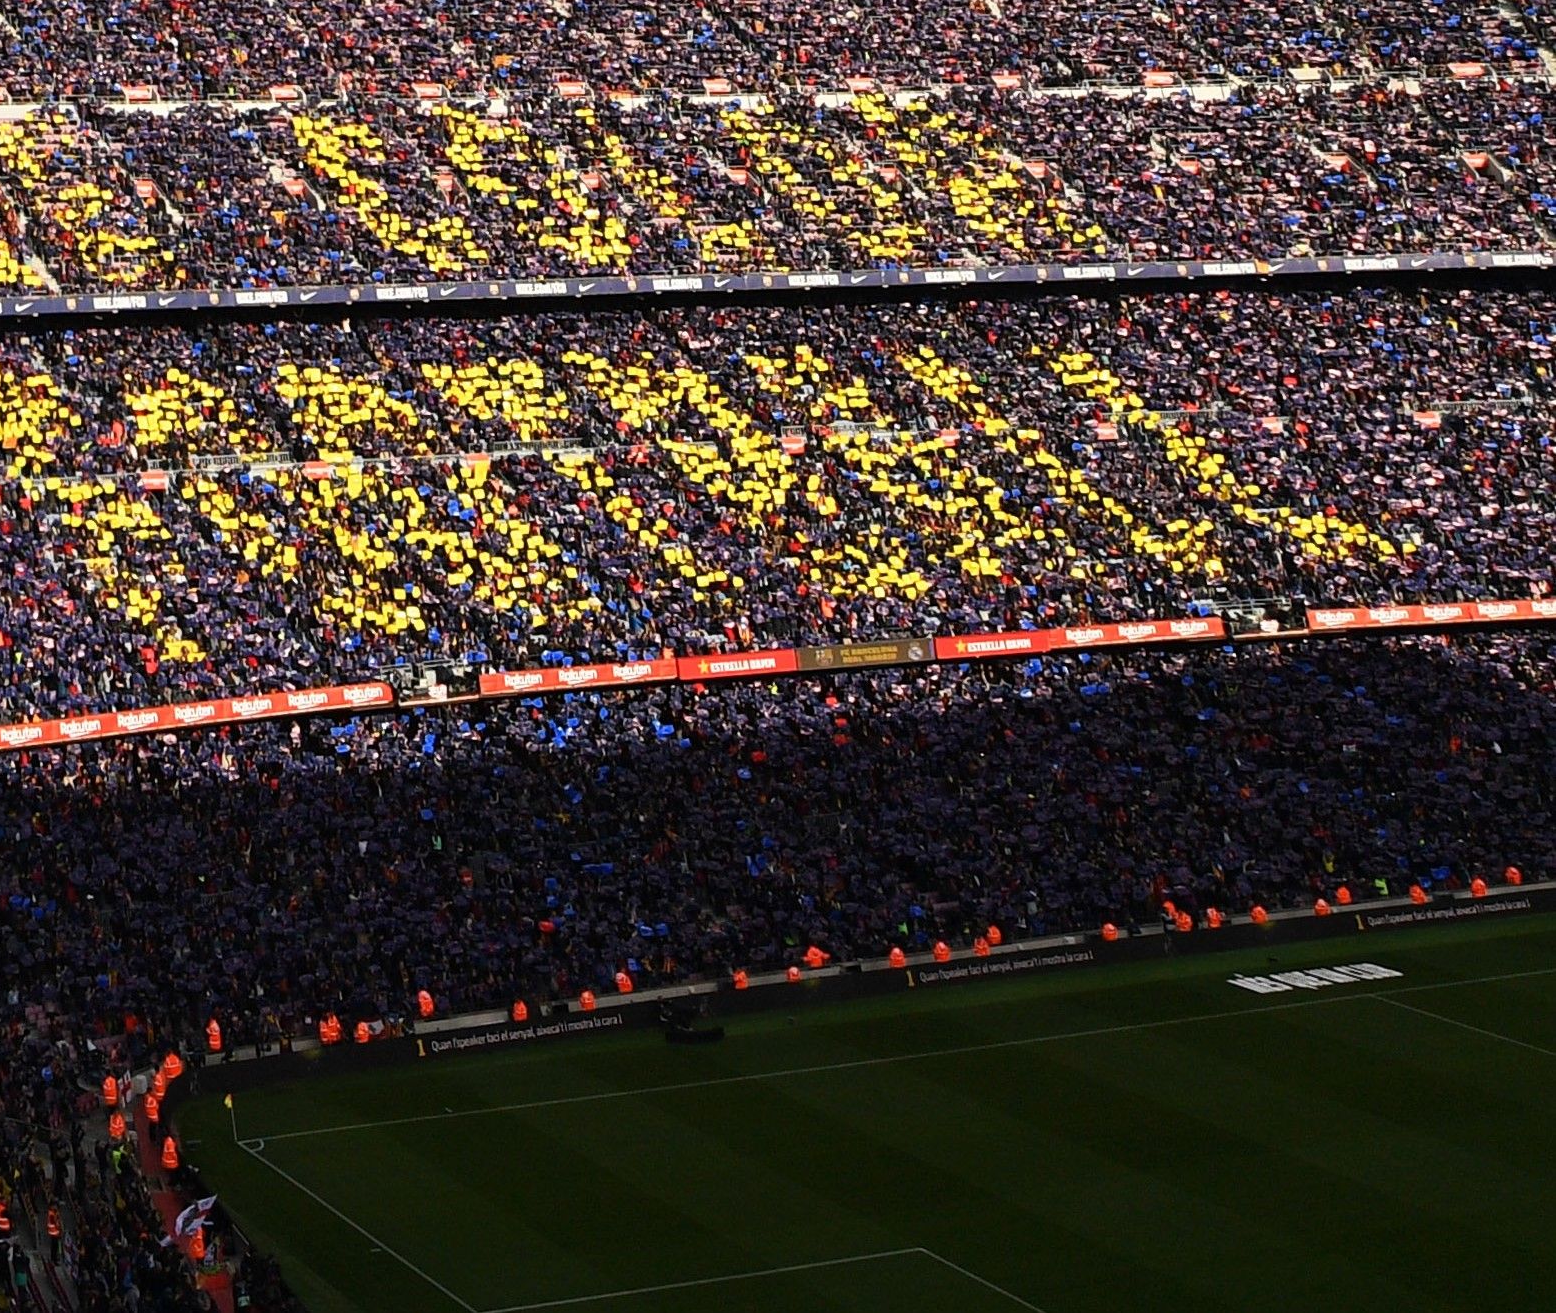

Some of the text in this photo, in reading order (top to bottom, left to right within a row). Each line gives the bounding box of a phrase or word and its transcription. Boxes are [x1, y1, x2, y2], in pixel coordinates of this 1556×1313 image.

[504, 670, 543, 686] Rakuten
[288, 690, 328, 707] Rakuten
[343, 684, 383, 701] Rakuten
[175, 704, 215, 721] Rakuten
[232, 696, 272, 713] Rakuten
